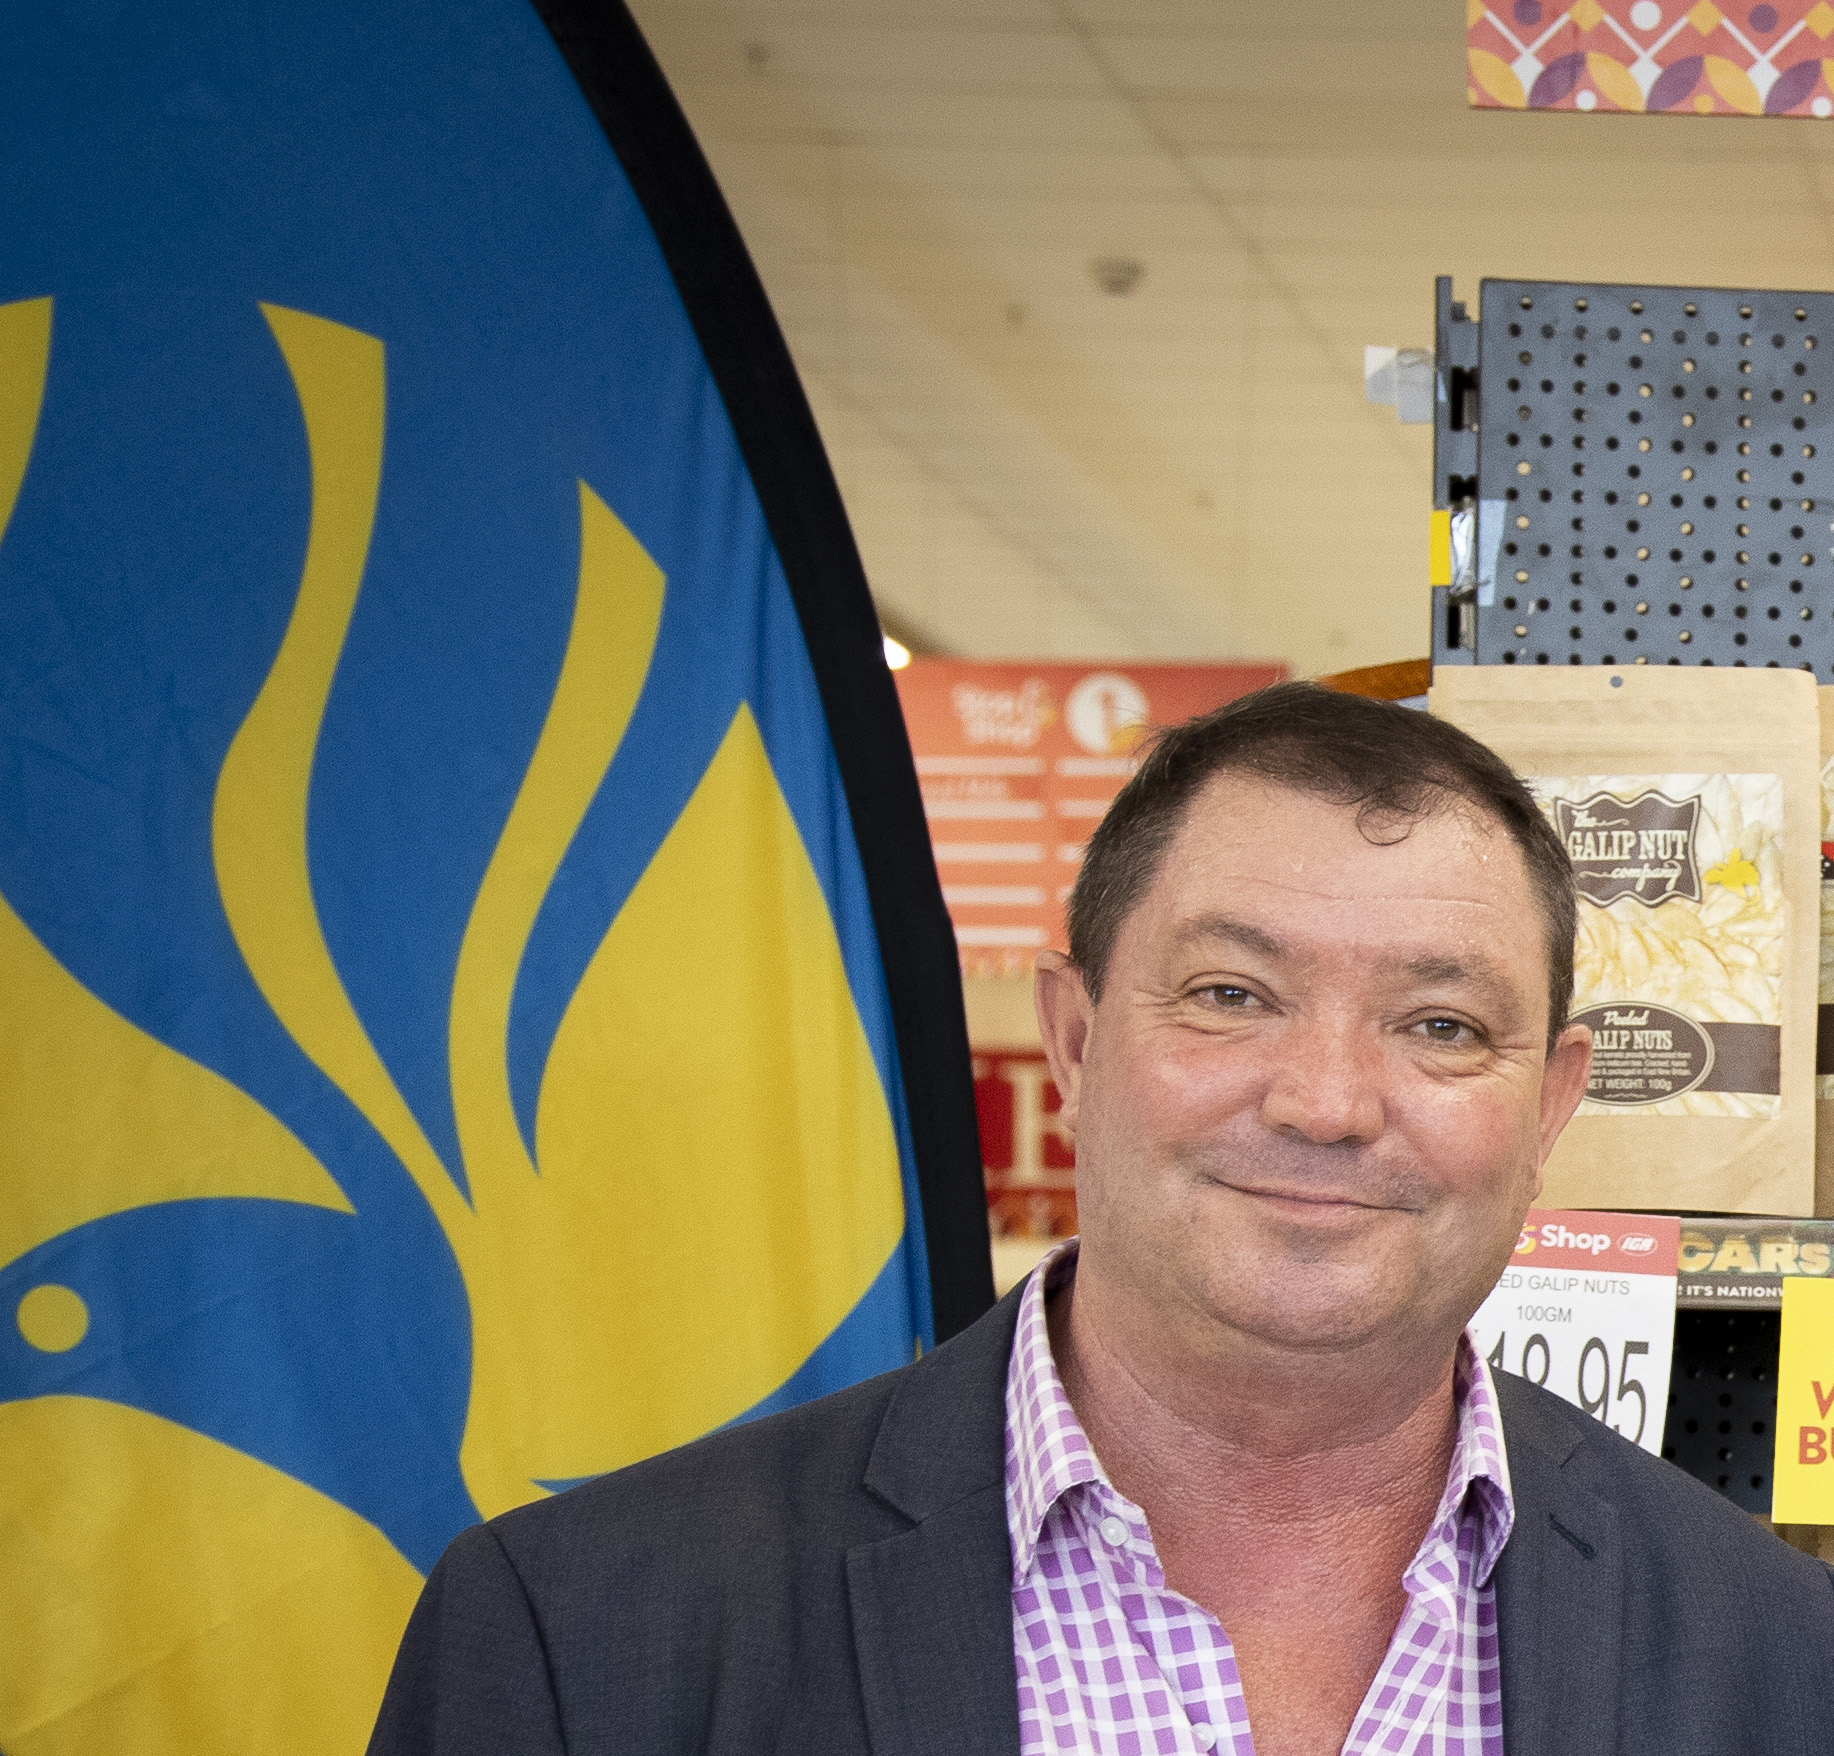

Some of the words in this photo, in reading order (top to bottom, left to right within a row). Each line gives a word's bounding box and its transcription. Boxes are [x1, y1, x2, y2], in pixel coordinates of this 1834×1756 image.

[1568, 830, 1636, 861] GALIP
[1638, 829, 1688, 860] NUT
[1633, 1030, 1673, 1050] NUTS
[1540, 1224, 1611, 1255] Shop
[1527, 1274, 1578, 1292] GALIP
[1583, 1278, 1631, 1295] NUTS
[1517, 1305, 1573, 1323] 100GM
